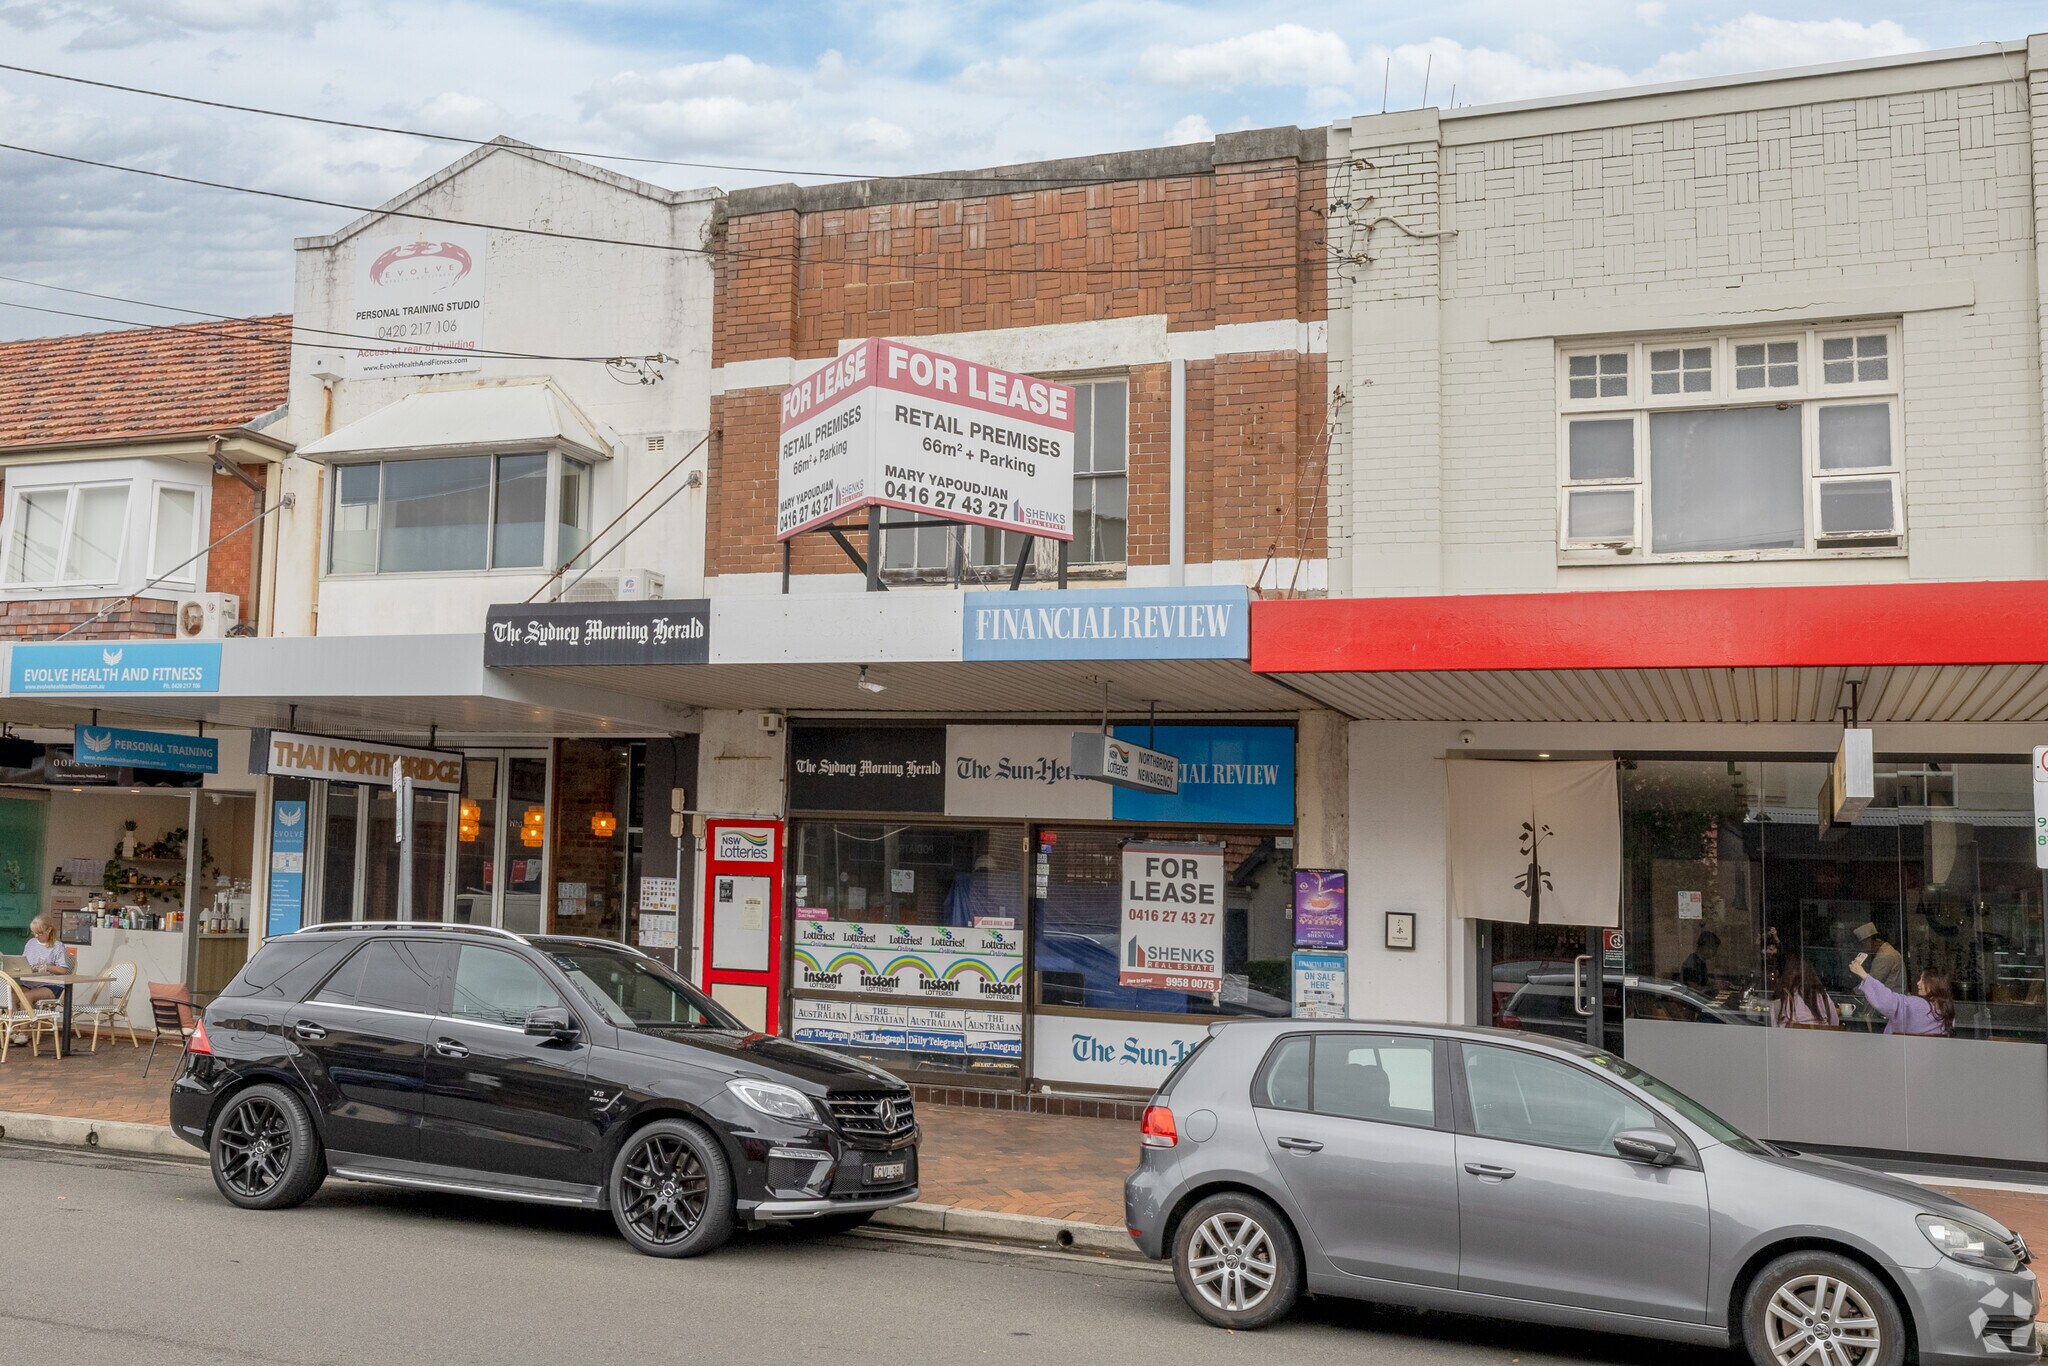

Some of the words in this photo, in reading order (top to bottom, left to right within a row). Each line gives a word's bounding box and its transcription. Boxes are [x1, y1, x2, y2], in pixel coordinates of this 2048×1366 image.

[385, 264, 455, 279] EVOLVE
[356, 307, 400, 320] PERSONAL
[402, 303, 444, 316] TRAINING
[446, 299, 480, 312] STUDIO
[378, 324, 407, 339] 0420
[410, 321, 432, 336] 217
[436, 318, 458, 333] 106
[357, 348, 389, 358] Access
[391, 347, 401, 355] at
[403, 344, 423, 354] rear
[425, 342, 436, 352] of
[437, 339, 475, 351] building
[363, 357, 468, 372] www.EvolveHealthAndFitness.com
[782, 381, 812, 424] FOR
[815, 345, 867, 402] LEASE
[888, 346, 958, 394] FOR
[968, 366, 1069, 421] LEASE
[783, 432, 813, 461] RETAIL
[815, 404, 862, 441] PREMISES
[895, 404, 964, 436] RETAIL
[969, 422, 1062, 459] PREMISES
[819, 439, 848, 463] Parking
[966, 450, 974, 461] +
[980, 448, 1036, 477] Parking
[841, 479, 865, 498] SHENKS
[884, 464, 924, 483] MARY
[929, 474, 1009, 501] YAPOUDJIAN
[780, 495, 795, 514] MARY
[795, 479, 834, 506] YAPOUDJIAN
[884, 480, 930, 506] 0416
[935, 491, 956, 510] 27
[961, 496, 983, 516] 43
[988, 500, 1009, 520] 27
[779, 511, 798, 533] 0416
[799, 505, 810, 524] 27
[811, 501, 822, 519] 43
[823, 493, 834, 514] 27
[1025, 507, 1066, 525] SHENKS
[976, 606, 1117, 640] FINANCIAL
[1121, 603, 1233, 639] REVIEW
[493, 620, 521, 646] The
[523, 620, 579, 646] Sydney
[584, 618, 649, 645] Morning
[652, 617, 704, 645] Herald
[24, 668, 69, 682] EVOLVE
[72, 668, 119, 682] HEALTH
[121, 667, 149, 681] AND
[152, 667, 203, 681] FITNESS
[114, 739, 165, 754] PERSONAL
[168, 744, 213, 758] TRAINING
[1109, 750, 1118, 760] NSW
[274, 740, 324, 770] THAI
[328, 746, 461, 784] NORTHBRIDGE
[796, 759, 817, 775] The
[818, 759, 856, 777] Sydney
[859, 759, 904, 777] Morning
[906, 760, 941, 778] Herald
[956, 756, 992, 780] The
[994, 757, 1097, 785] Sun-Her
[1107, 758, 1129, 778] Lotteries
[1138, 751, 1174, 772] NORTHBRIDGE
[1137, 768, 1173, 788] NEWSAGENCY
[1212, 764, 1279, 785] REVIEW
[274, 829, 304, 838] EVOLVE
[722, 837, 741, 845] NSW
[720, 845, 768, 859] Lotteries
[1146, 857, 1199, 879] FOR
[1130, 880, 1215, 905] LEASE
[1128, 908, 1159, 922] 0416
[1162, 910, 1177, 923] 27
[1181, 911, 1196, 924] 43
[1200, 912, 1215, 925] 27
[803, 930, 835, 941] Lotteries!
[843, 932, 876, 943] Lotteries!
[889, 935, 922, 945] Lotteries!
[931, 937, 965, 948] Lotteries!
[981, 940, 1016, 950] Lotteries!
[1148, 946, 1215, 963] SHENKS
[1147, 961, 1172, 969] REAL
[1177, 963, 1214, 972] ESTATE
[1298, 960, 1322, 968] FINANCIAL
[804, 966, 843, 984] instant
[860, 970, 900, 988] instant
[919, 973, 960, 991] instant
[1166, 977, 1189, 987] 9958
[1191, 979, 1214, 989] 0075
[1304, 972, 1315, 980] ON
[1317, 973, 1336, 981] SALE
[809, 982, 836, 990] LOTTERIES!
[979, 976, 1021, 995] instant
[1311, 981, 1330, 989] HERE
[798, 1009, 847, 1020] AUSTRALIAN
[854, 1012, 905, 1024] AUSTRALIAN
[872, 1007, 888, 1015] THE
[929, 1010, 945, 1018] THE
[987, 1014, 1004, 1022] THE
[910, 1016, 962, 1028] AUSTRALIAN
[967, 1020, 1022, 1032] AUSTRALIAN
[815, 1028, 848, 1041] Telegraph
[870, 1032, 905, 1046] Telegraph
[908, 1035, 928, 1047] Daily
[928, 1037, 964, 1050] Telegraph
[1072, 1033, 1116, 1063] The
